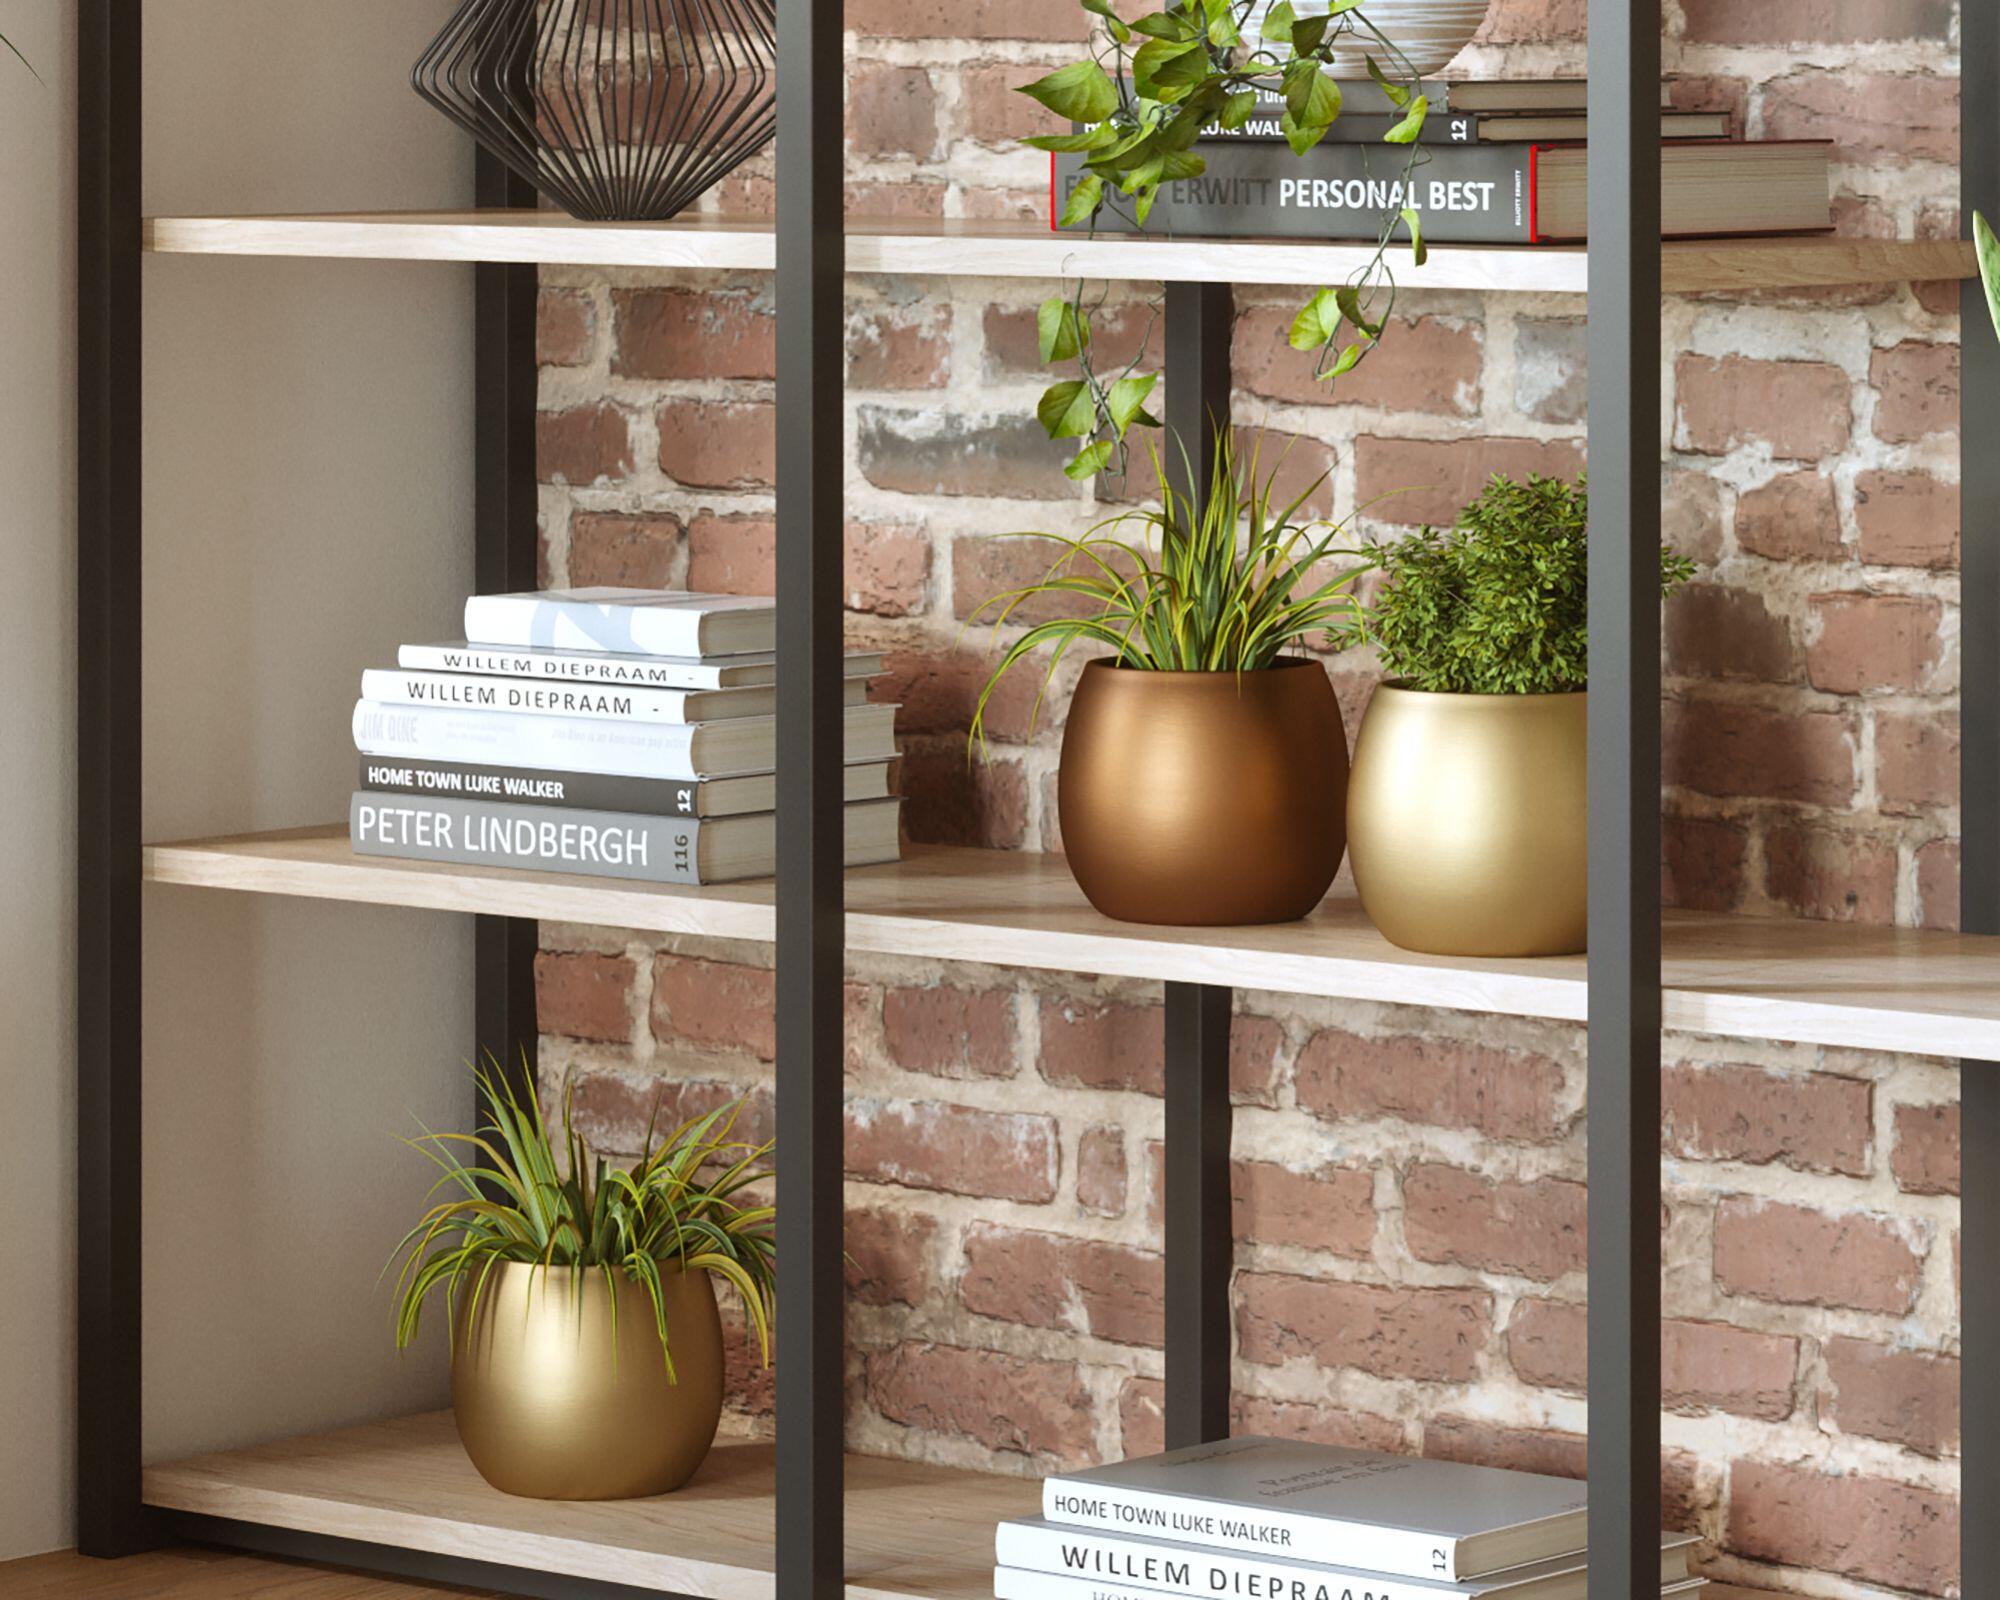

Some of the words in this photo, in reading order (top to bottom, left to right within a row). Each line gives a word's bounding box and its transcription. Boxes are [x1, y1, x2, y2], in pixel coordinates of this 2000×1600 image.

[1245, 120, 1285, 136] WAL
[1451, 119, 1467, 141] 12
[1171, 177, 1272, 206] ERWITT
[1279, 178, 1422, 210] PERSONAL
[1429, 181, 1494, 211] BEST
[443, 654, 532, 673] WILLEM
[544, 661, 668, 682] DIEPRAAM
[407, 681, 496, 704] WILLEM
[508, 688, 632, 715] DIEPRAAM
[367, 766, 413, 787] HOME
[415, 770, 462, 792] TOWN
[464, 776, 501, 794] LUKE
[503, 778, 565, 799] WALKER
[676, 788, 692, 813] 12
[358, 805, 454, 849] PETER
[463, 814, 648, 867] LINDBERGH
[673, 834, 690, 873] 116
[1054, 1494, 1108, 1519] HOME
[1112, 1502, 1167, 1527] TOWN
[1172, 1512, 1215, 1535] LUKE
[1219, 1519, 1292, 1547] WALKER
[1061, 1544, 1190, 1586] WILLEM
[1432, 1548, 1447, 1572] 12
